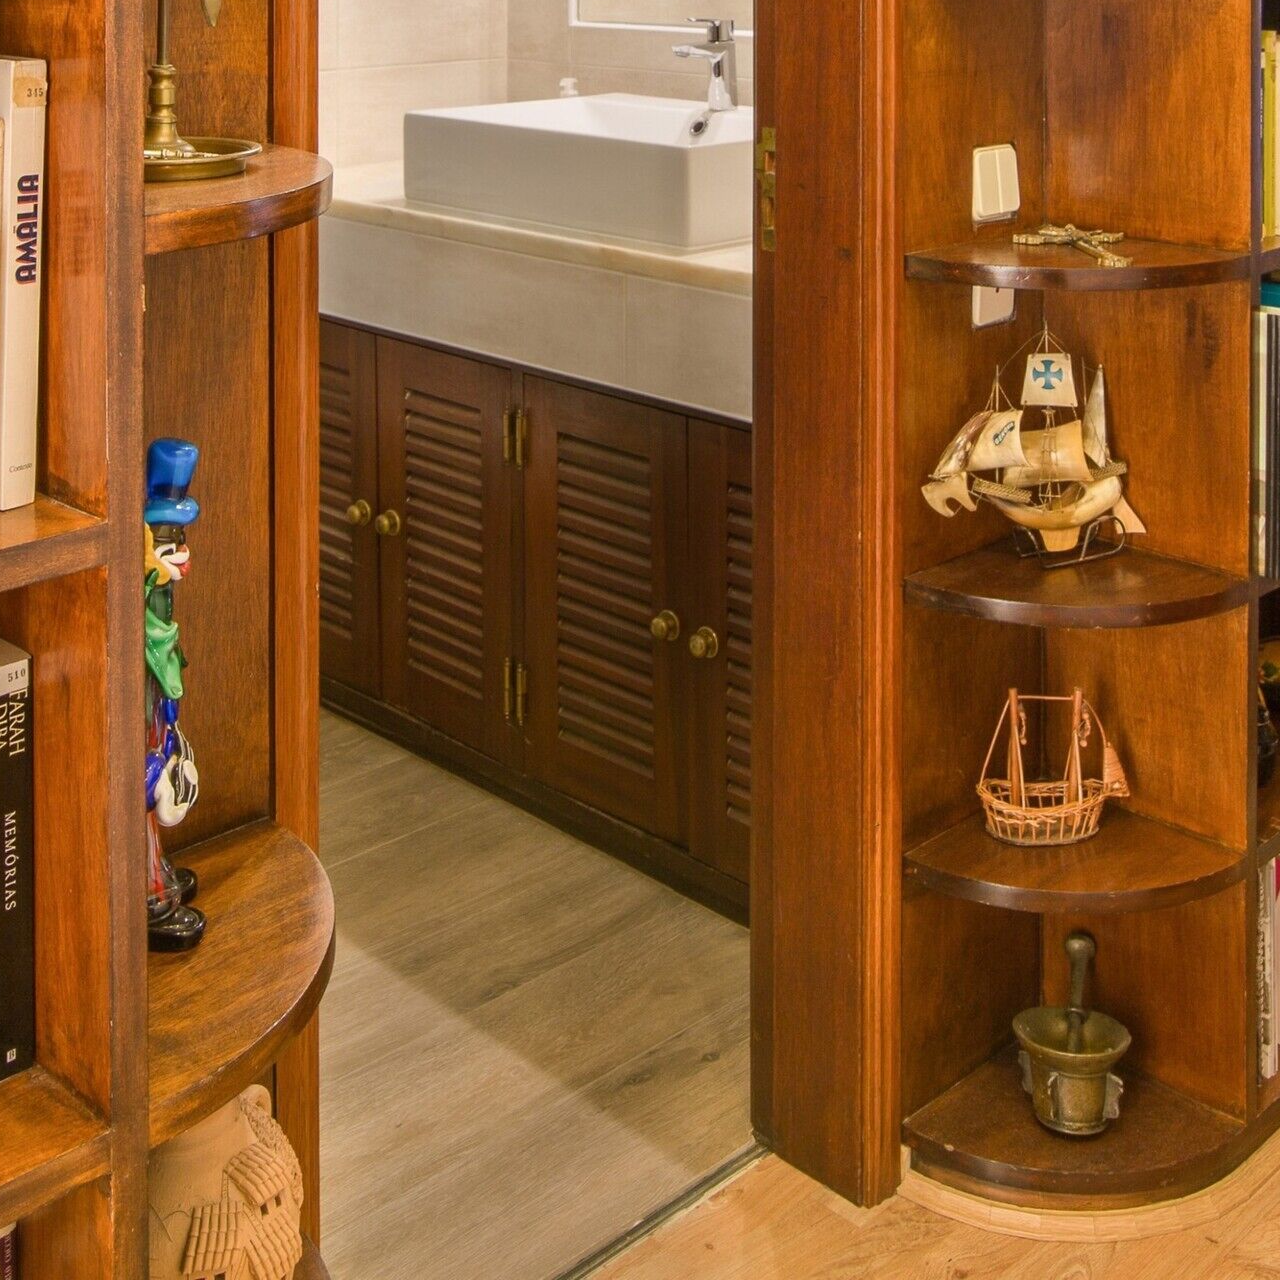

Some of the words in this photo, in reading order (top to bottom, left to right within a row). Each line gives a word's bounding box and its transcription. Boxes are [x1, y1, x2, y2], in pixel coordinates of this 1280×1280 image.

[13, 174, 39, 284] AMÁLIA
[9, 689, 29, 756] FARAH
[5, 811, 17, 911] MEMÓRIAS
